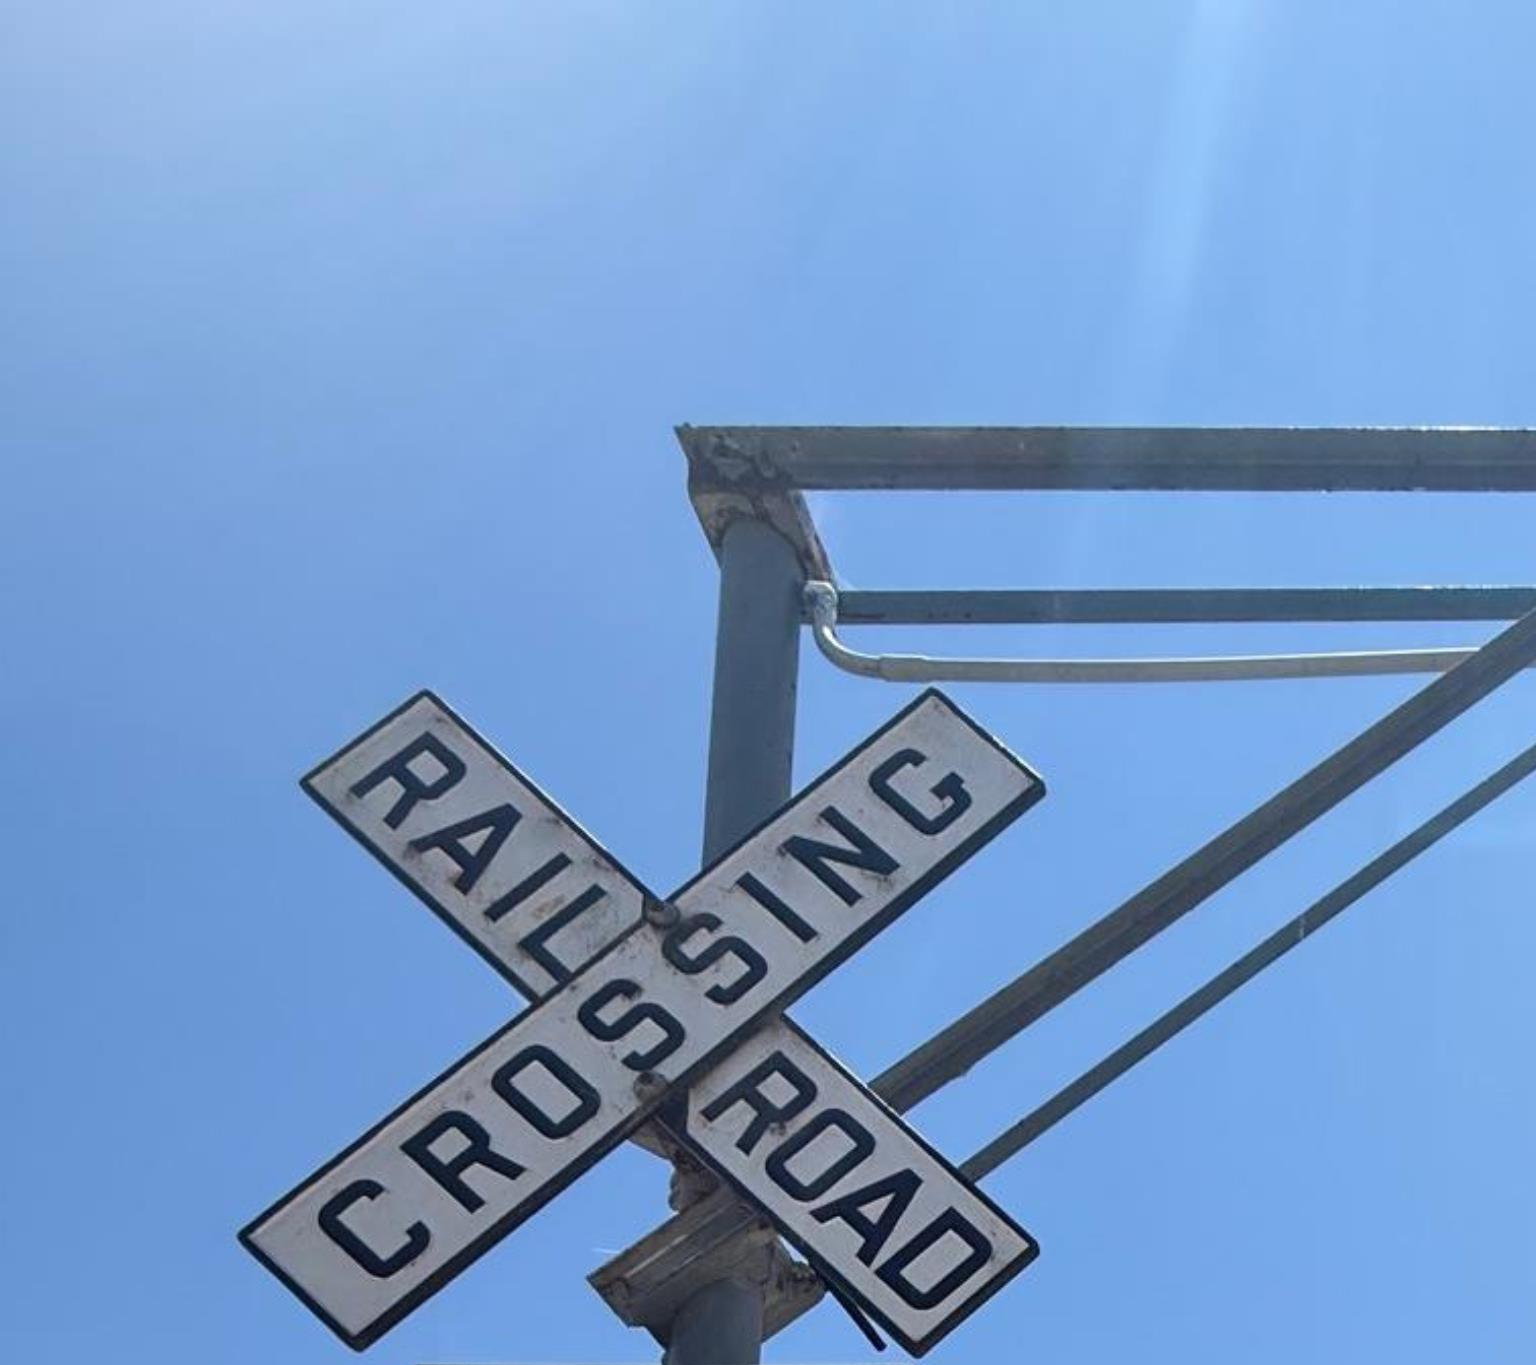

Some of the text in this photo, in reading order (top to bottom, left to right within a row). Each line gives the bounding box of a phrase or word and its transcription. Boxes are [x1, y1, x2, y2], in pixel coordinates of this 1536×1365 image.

[348, 731, 606, 984] RAIL
[317, 747, 974, 1279] CROSSING
[699, 1050, 993, 1311] ROAD
